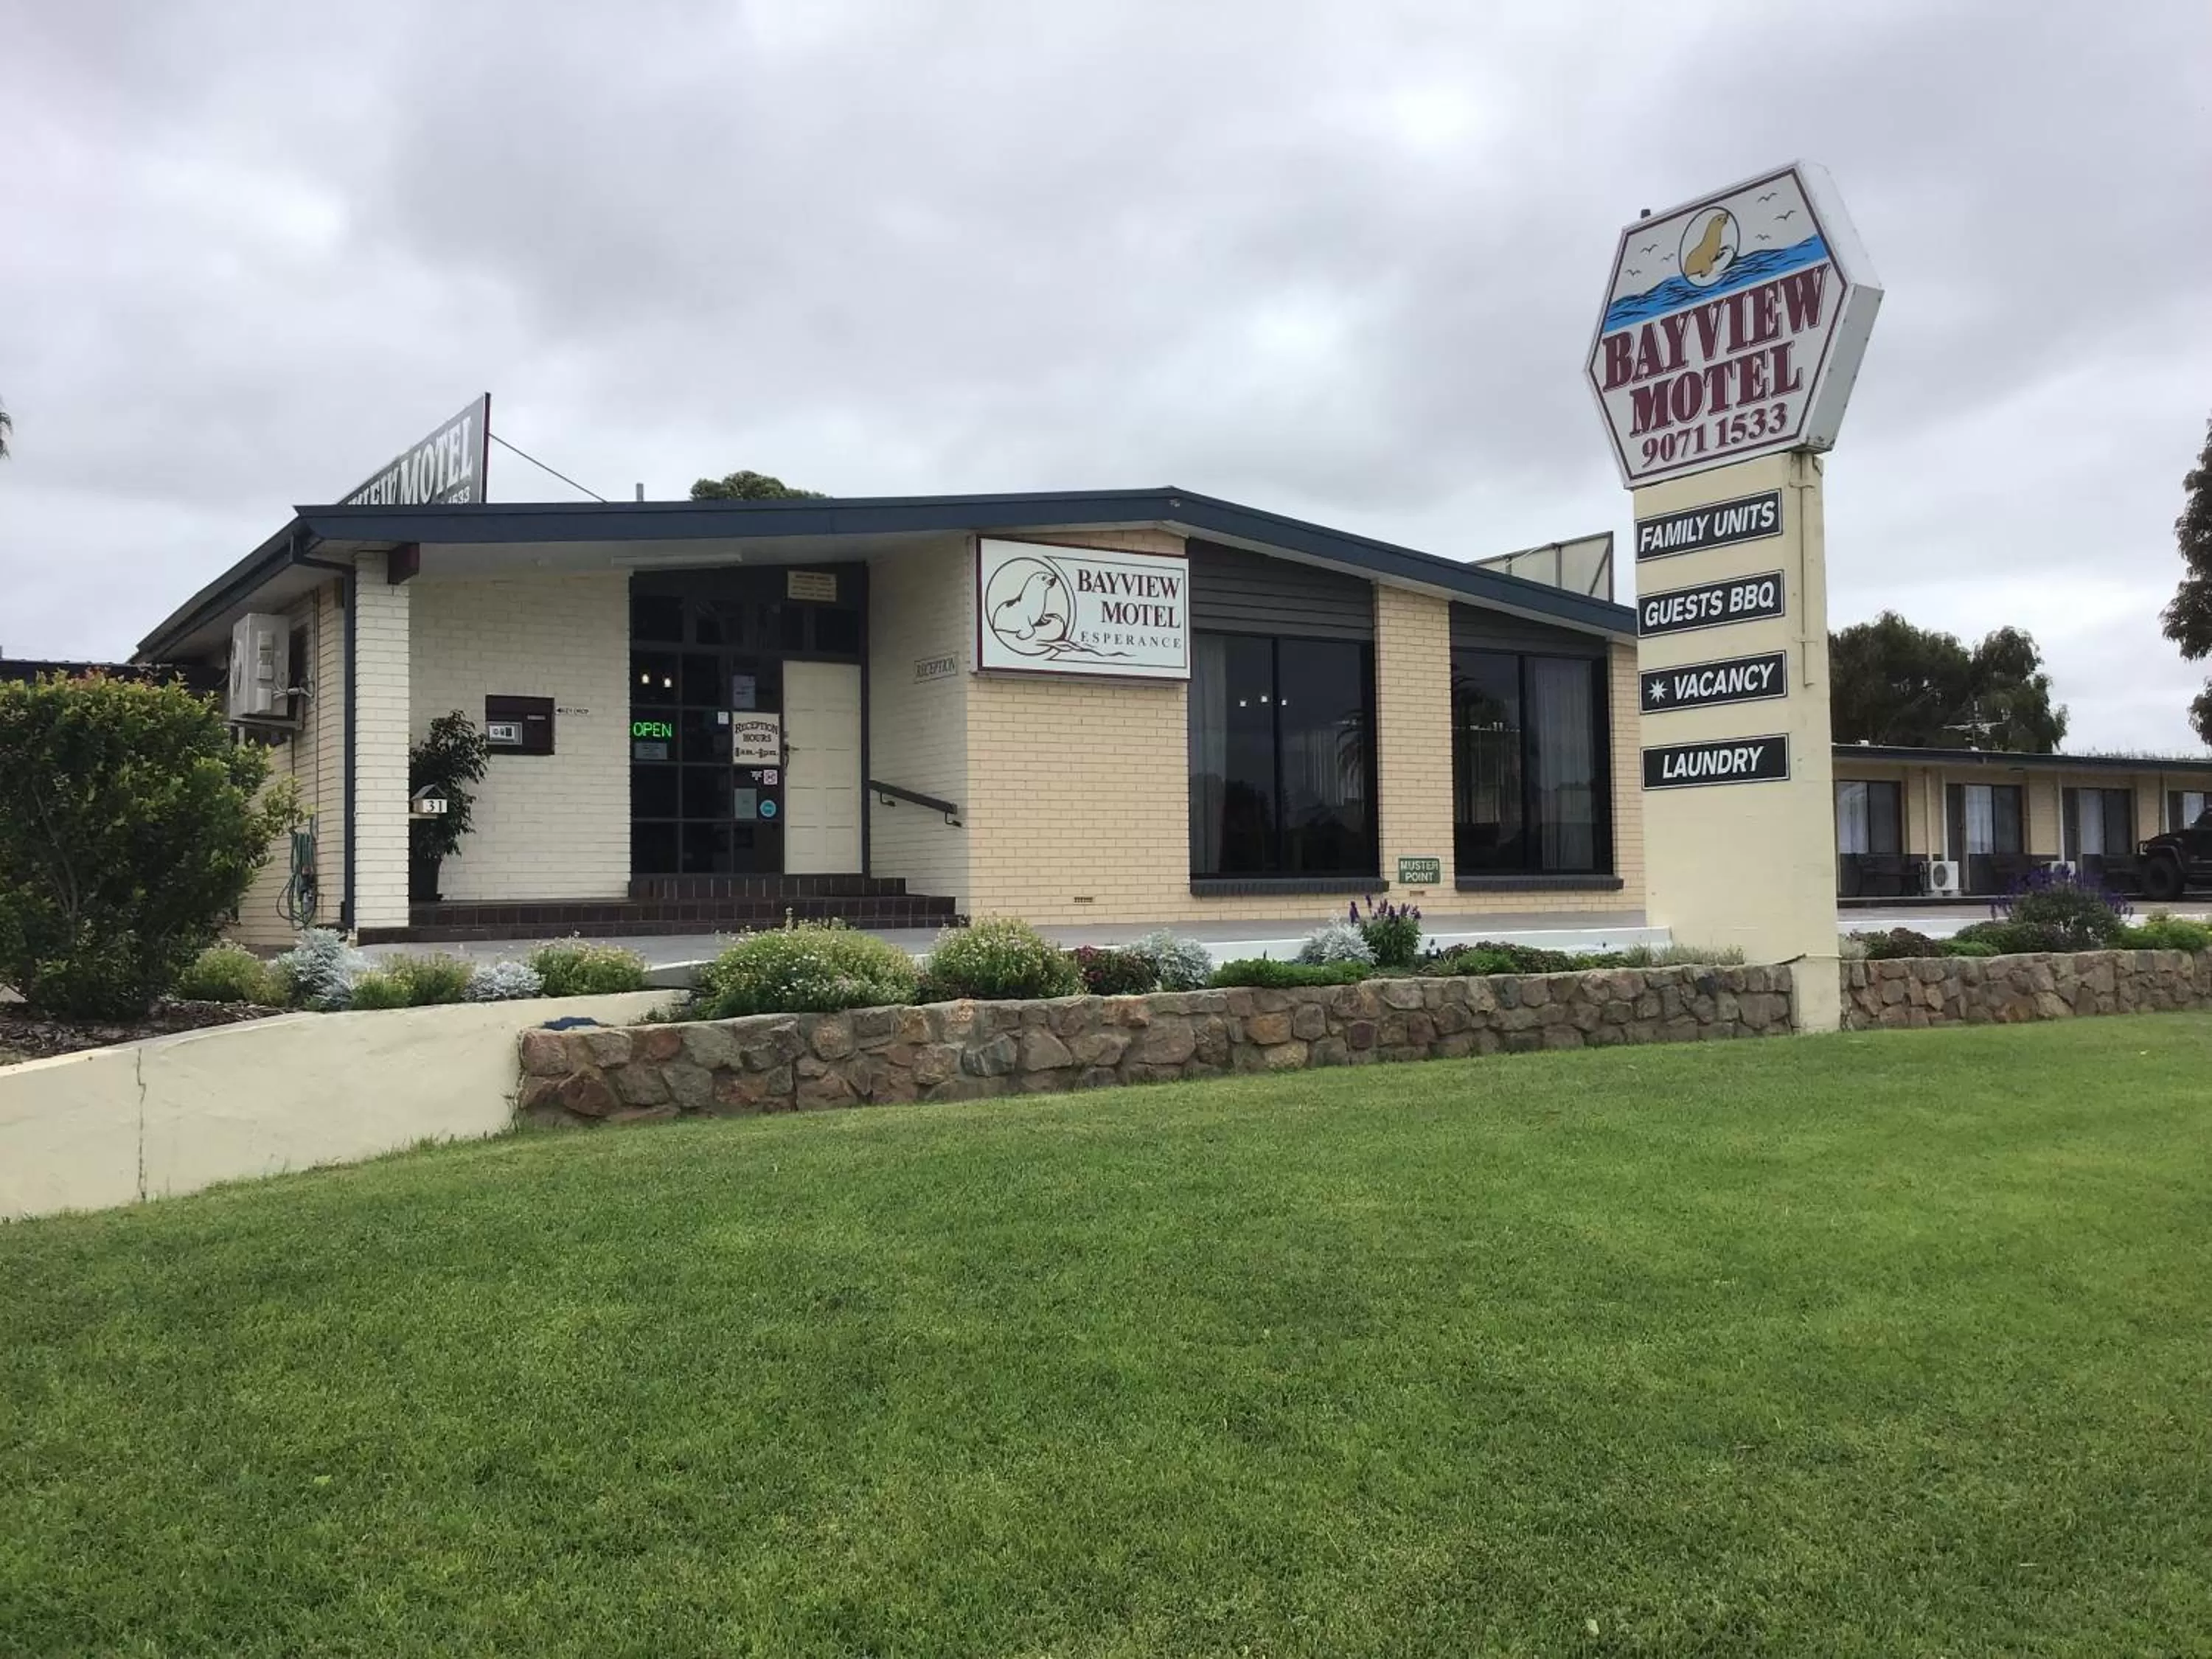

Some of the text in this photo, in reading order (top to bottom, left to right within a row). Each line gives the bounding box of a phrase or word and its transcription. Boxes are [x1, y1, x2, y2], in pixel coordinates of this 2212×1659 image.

[1602, 262, 1830, 392] BAYVIEW
[1630, 341, 1803, 437] MOTEL
[1641, 402, 1788, 468] 9071 1533
[400, 416, 473, 504] MOTEL
[1639, 501, 1775, 552] FAMILY UNITS
[1077, 568, 1181, 599] BAYVIEW
[1101, 601, 1180, 628] MOTEL
[1644, 581, 1775, 627] GUESTS BBQ
[1080, 631, 1182, 649] ESPERANCE
[1674, 662, 1776, 700] VACANCY
[634, 722, 672, 737] OPEN
[734, 721, 778, 735] RECEPTION
[742, 734, 771, 742] HOURS
[1663, 745, 1764, 779] LAUNDRY
[427, 800, 442, 812] 31
[1401, 860, 1438, 870] MUSTER
[1405, 872, 1434, 882] POINT
